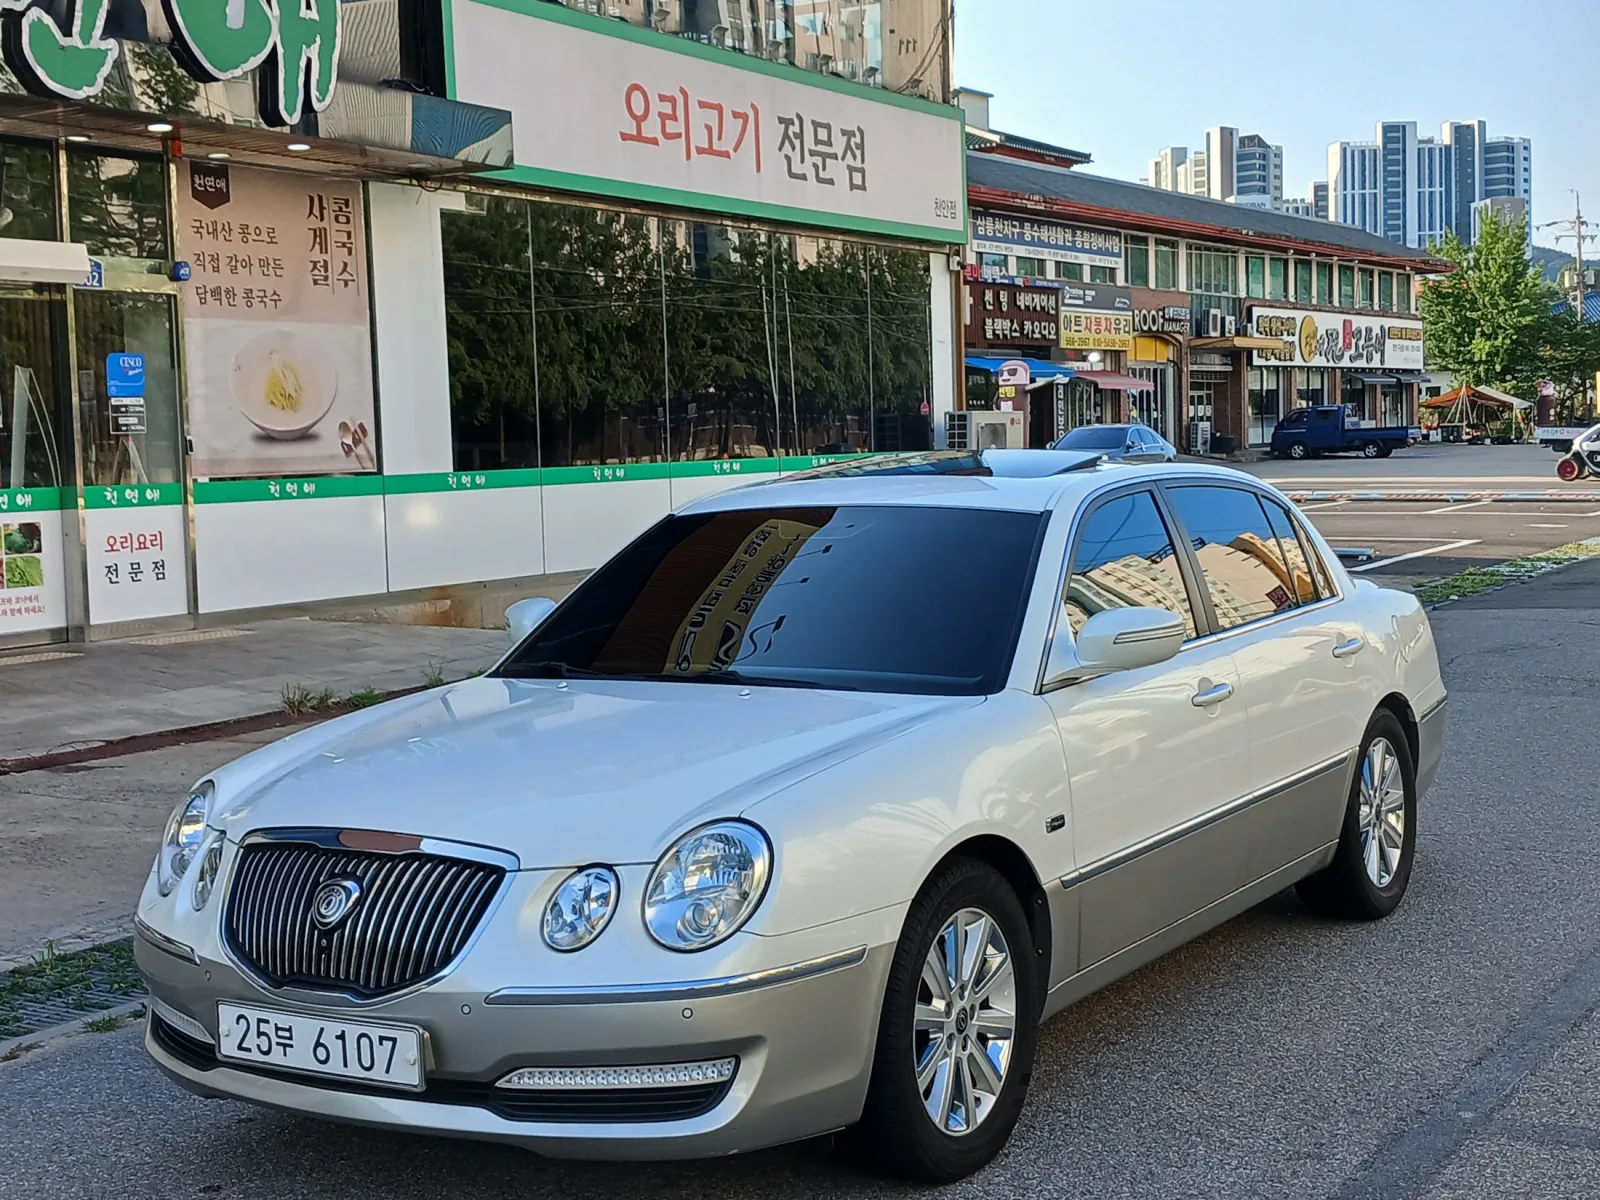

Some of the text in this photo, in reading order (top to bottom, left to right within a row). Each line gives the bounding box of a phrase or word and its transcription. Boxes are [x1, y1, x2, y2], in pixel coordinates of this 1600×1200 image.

[619, 82, 868, 192] 오리고기 전문점
[193, 175, 227, 193] 천연애
[934, 197, 957, 221] 천안점
[191, 218, 279, 245] 국내산 콩으로
[306, 193, 330, 287] 사계절
[332, 197, 356, 288] 콩국수
[1023, 222, 1072, 246] 풍수해생활권
[1075, 230, 1120, 253] 종합정비사업
[193, 251, 285, 278] 직접 갈아 만든
[195, 284, 282, 310] 담백한 콩국수
[1016, 291, 1056, 315] 네비게이션
[984, 317, 1057, 340] 블랙박스 카오디오
[1063, 314, 1131, 336] 아트자동차유리
[1134, 309, 1163, 331] ROOF
[1163, 321, 1190, 333] MANAGER
[268, 480, 316, 497] 천연애
[447, 474, 486, 489] 천연애
[103, 486, 161, 505] 천연애
[104, 530, 163, 554] 오리요리
[104, 559, 167, 585] 전문점
[235, 1013, 398, 1075] 25부 6107
